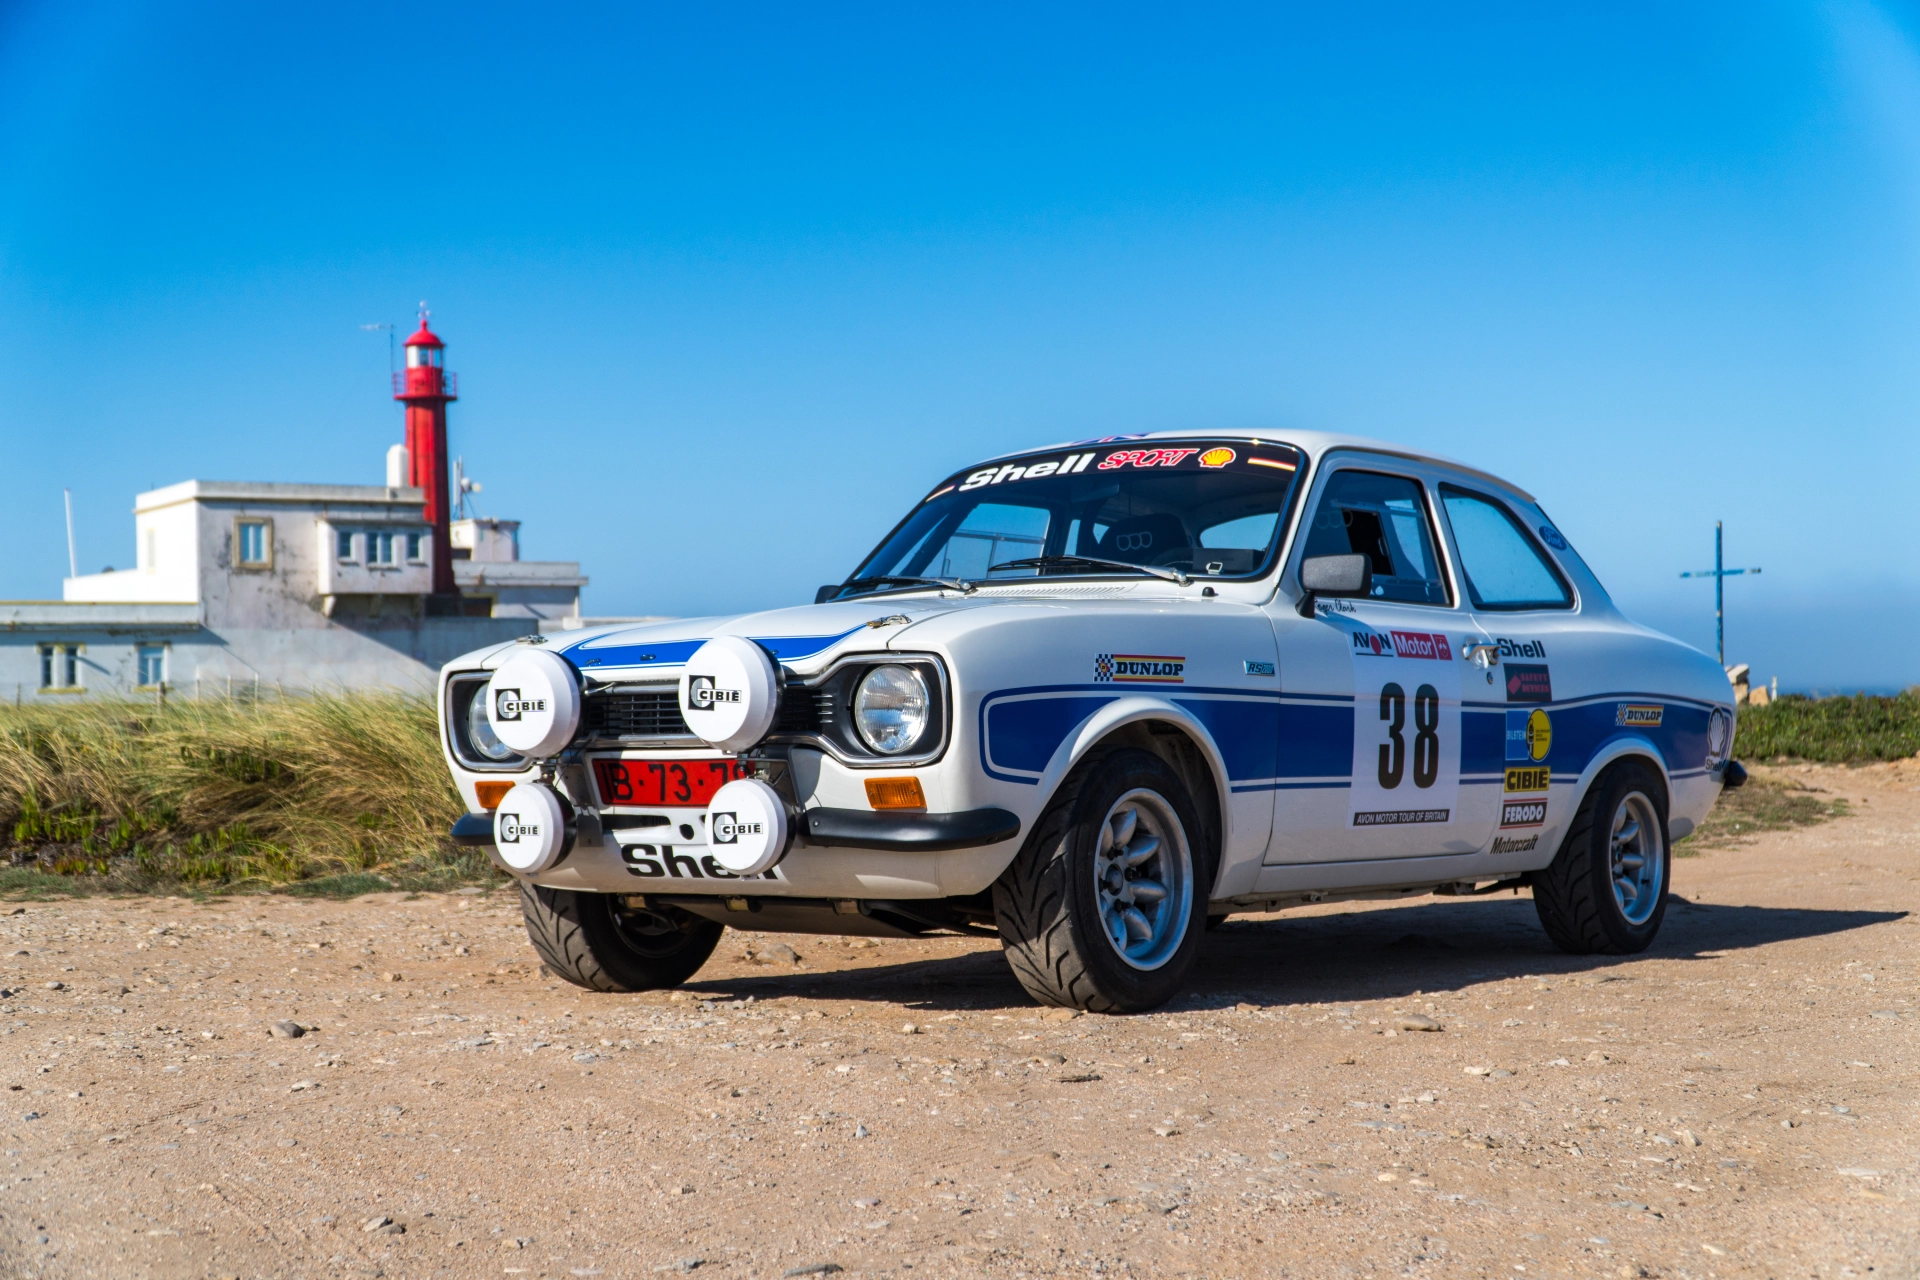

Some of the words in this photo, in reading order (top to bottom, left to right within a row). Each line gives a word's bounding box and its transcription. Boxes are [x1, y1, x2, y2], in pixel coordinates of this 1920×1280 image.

[958, 452, 1096, 492] Shell
[1097, 448, 1200, 470] SPORT
[1353, 632, 1392, 655] AVON
[1395, 633, 1433, 656] Motor
[1497, 637, 1546, 659] Shell
[1115, 661, 1184, 676] DUNLOP
[1521, 673, 1548, 682] SAFETY
[1522, 684, 1549, 693] DEVICES
[1627, 710, 1662, 721] DUNLOP
[1378, 682, 1440, 790] 38
[1507, 730, 1526, 740] BILSTEIN
[1357, 813, 1375, 825] AVON
[1375, 813, 1398, 824] MOTOR
[1398, 812, 1415, 823] TOUR
[1415, 812, 1424, 822] OF
[1424, 811, 1447, 822] BRITAIN
[1504, 804, 1544, 824] FERODO
[1490, 834, 1539, 855] Motorcraft
